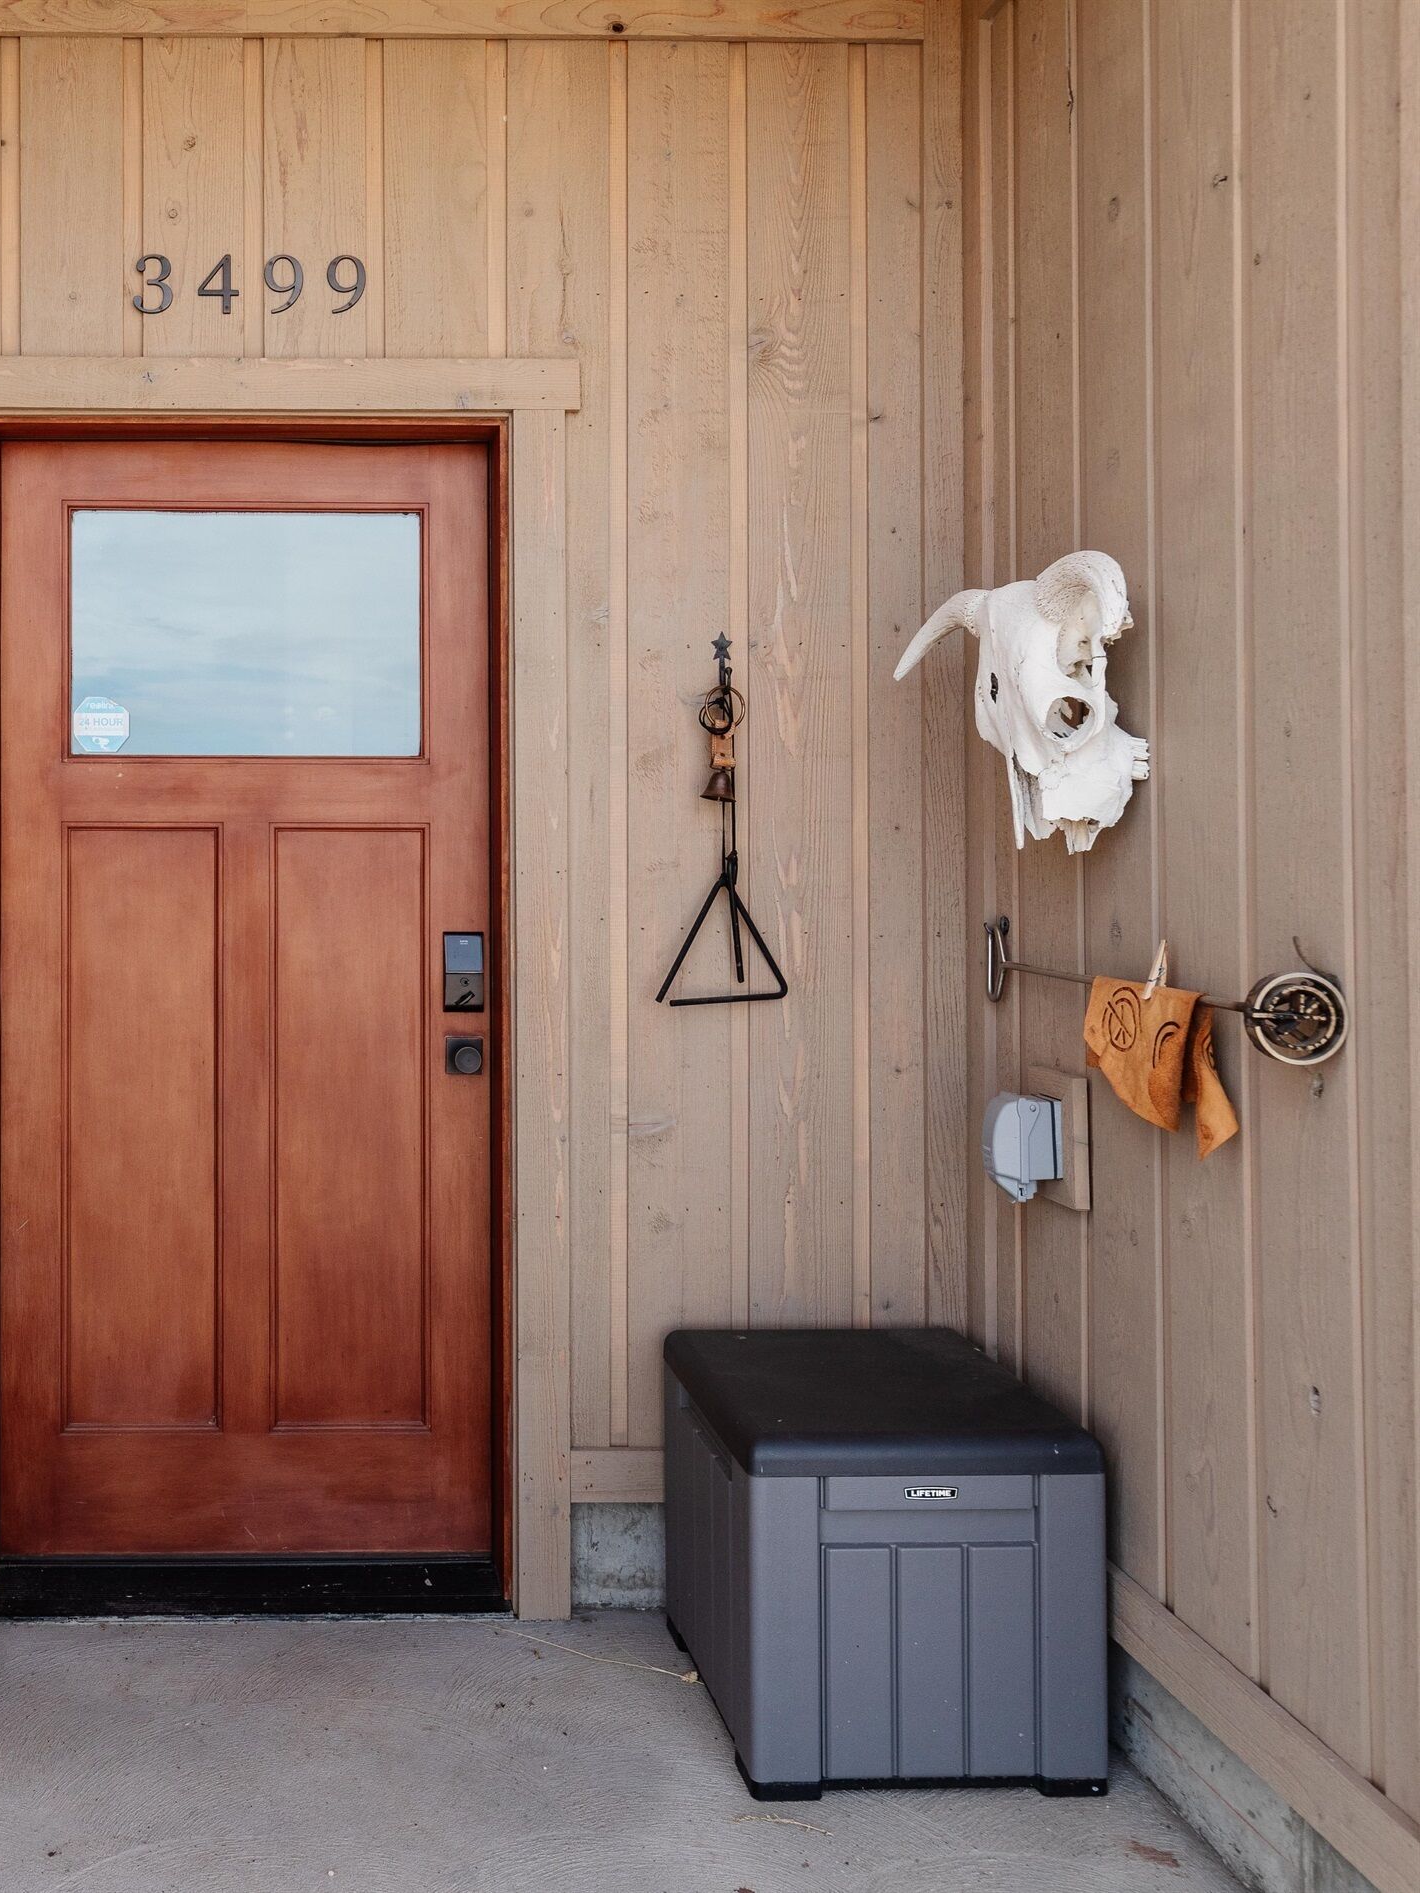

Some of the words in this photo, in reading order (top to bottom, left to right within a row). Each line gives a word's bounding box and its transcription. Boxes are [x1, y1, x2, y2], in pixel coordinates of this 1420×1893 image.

[132, 253, 367, 314] 3499
[93, 717, 123, 727] HOUR
[910, 1489, 952, 1497] LIFETIME
